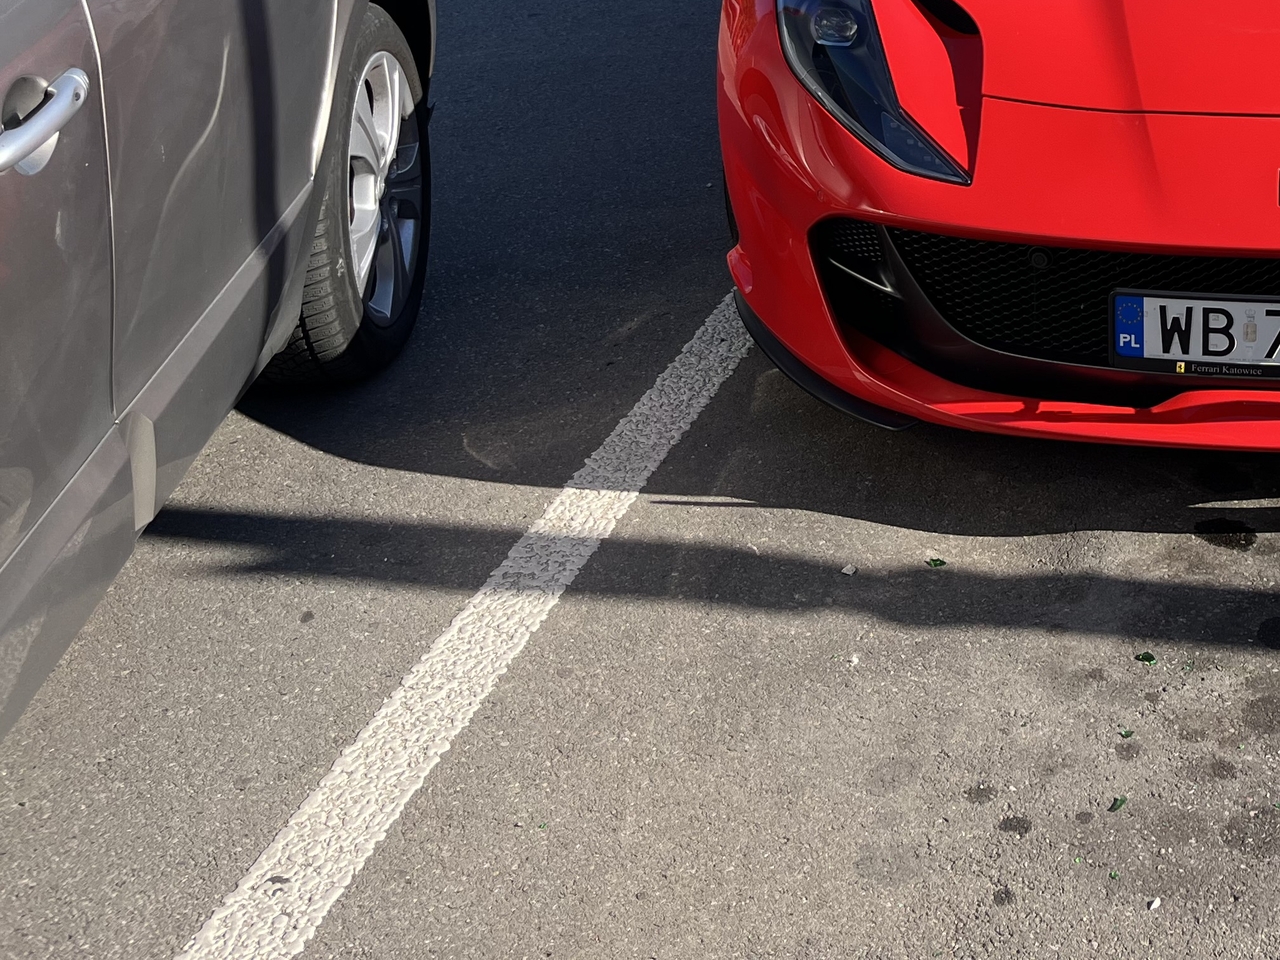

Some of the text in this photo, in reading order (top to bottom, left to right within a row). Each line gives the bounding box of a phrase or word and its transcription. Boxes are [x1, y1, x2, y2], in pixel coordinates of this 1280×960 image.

[1159, 305, 1237, 356] WB
[1119, 333, 1140, 348] PL
[1191, 364, 1262, 376] Ferrari Katowice
